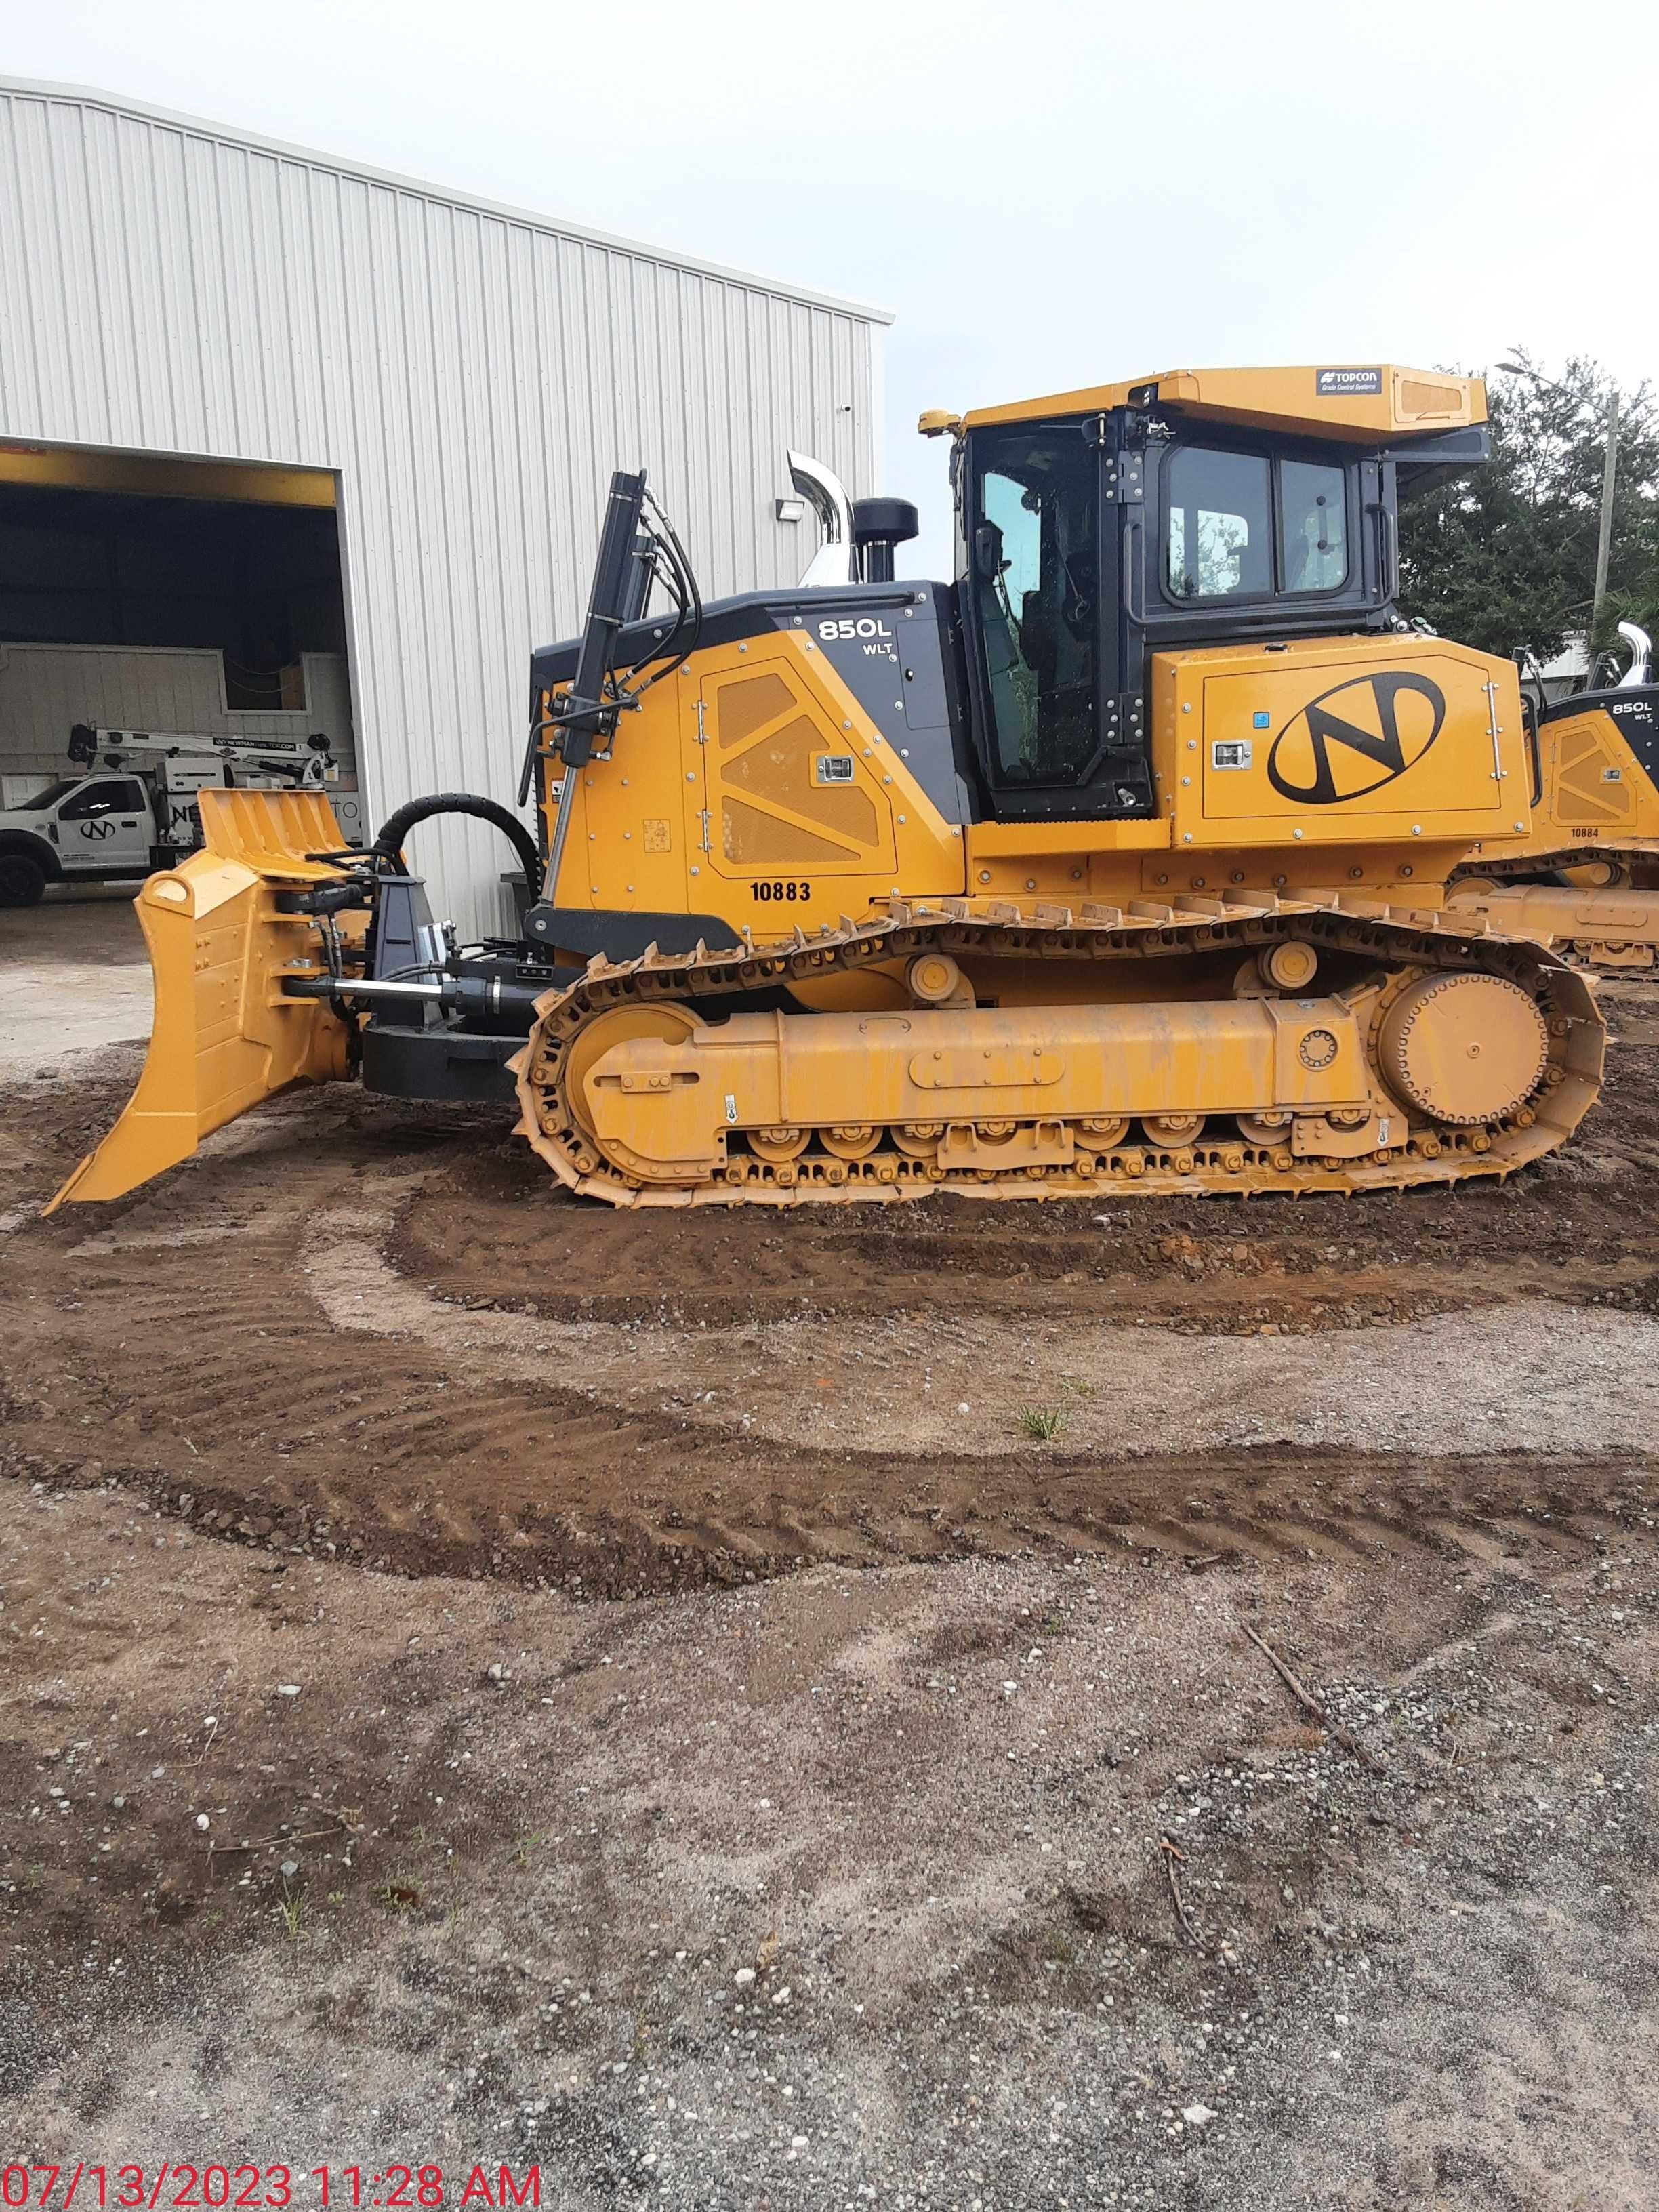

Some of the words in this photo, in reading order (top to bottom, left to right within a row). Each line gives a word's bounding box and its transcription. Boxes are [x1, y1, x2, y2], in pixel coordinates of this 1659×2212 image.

[1336, 373, 1377, 382] TOPCON
[819, 618, 892, 640] 850L
[863, 643, 893, 655] WLT
[1613, 702, 1652, 714] 850L
[1572, 828, 1598, 838] 10884
[750, 882, 810, 901] 10883
